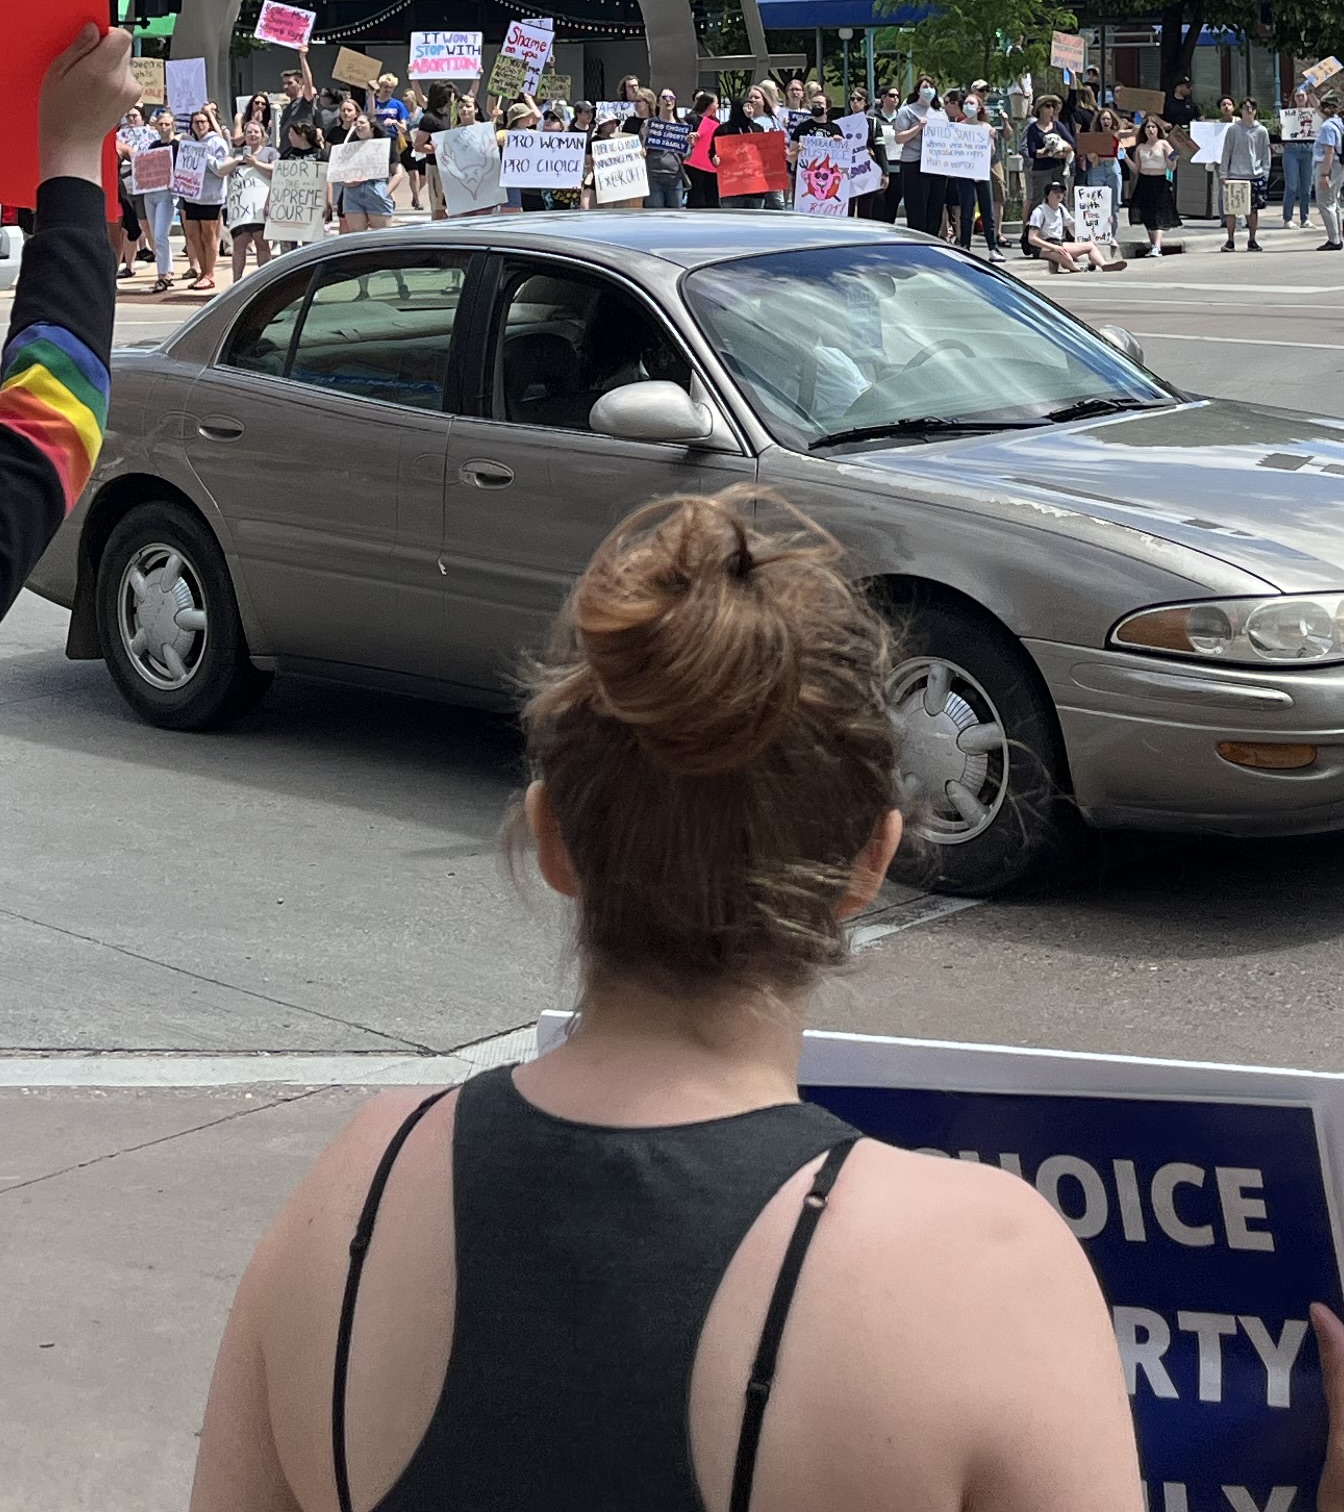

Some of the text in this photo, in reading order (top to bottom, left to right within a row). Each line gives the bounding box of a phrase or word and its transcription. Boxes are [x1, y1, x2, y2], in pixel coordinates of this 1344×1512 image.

[422, 32, 440, 45] IT
[507, 25, 549, 54] Shame
[415, 44, 483, 59] STOP WITH
[412, 56, 478, 74] ABORTION
[506, 134, 585, 152] PRO WOMAN
[275, 161, 325, 178] ABORT
[503, 159, 582, 175] PRO CHOICE
[271, 188, 323, 208] SUPREME
[269, 205, 319, 223] COURT
